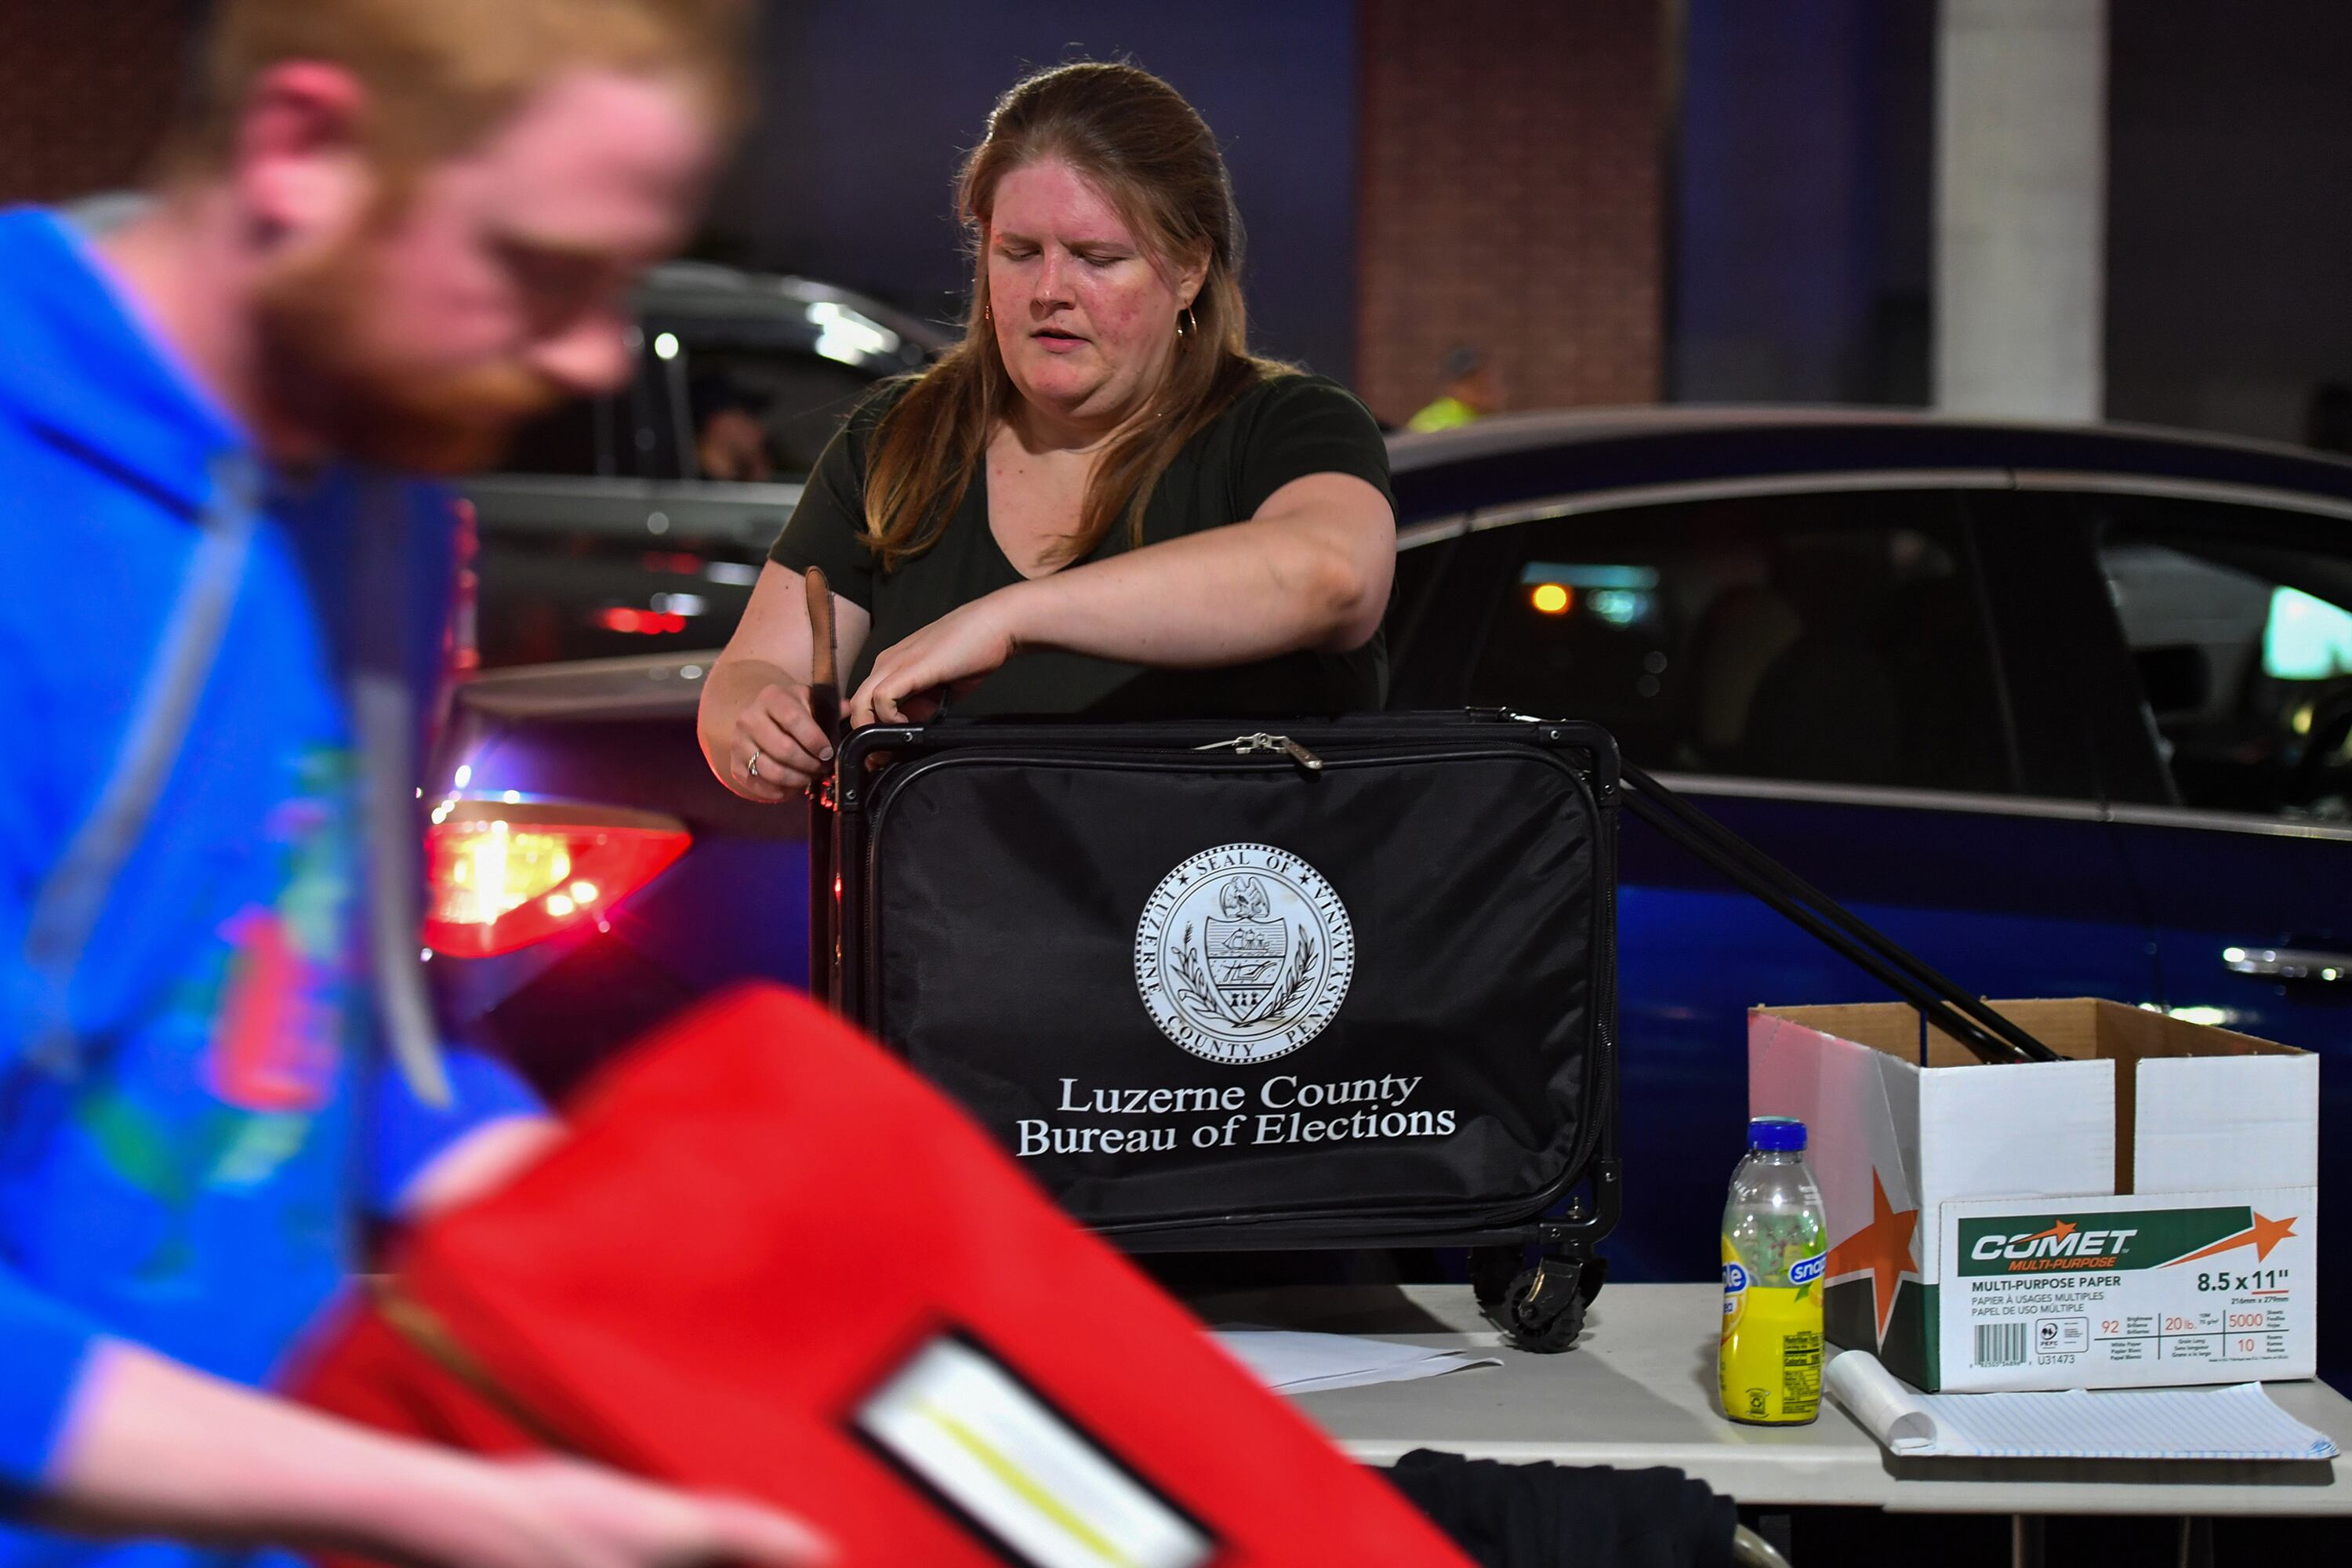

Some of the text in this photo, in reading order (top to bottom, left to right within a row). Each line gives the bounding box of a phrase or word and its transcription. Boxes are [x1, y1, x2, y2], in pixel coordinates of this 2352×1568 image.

[1196, 851, 1292, 875] SEAL OF
[1142, 887, 1346, 1057] LUZERNE COUNTY PENNSYLVANIA
[1057, 1073, 1423, 1113] Luzerne County
[1016, 1105, 1456, 1156] Bureau of Elections
[1971, 1229, 2139, 1260] COMET
[2008, 1257, 2118, 1271] MULTI-PURPOSE
[1972, 1276, 2121, 1292] MULTI-PURPOSE PAPER
[2198, 1272, 2230, 1292] 8.5
[2234, 1276, 2249, 1290] x
[1972, 1296, 2003, 1305] PAPIER
[2016, 1294, 2053, 1304] USAGES
[2055, 1292, 2104, 1301] MULTIPLES
[1972, 1308, 1999, 1316] PAPEL
[2018, 1305, 2038, 1314] USO
[2040, 1303, 2084, 1313] MÚLTIPLE
[2102, 1320, 2119, 1334] 92
[2165, 1317, 2183, 1330] 20
[2229, 1313, 2263, 1327] 5000
[2238, 1338, 2255, 1352] 10
[2038, 1355, 2075, 1366] U31473
